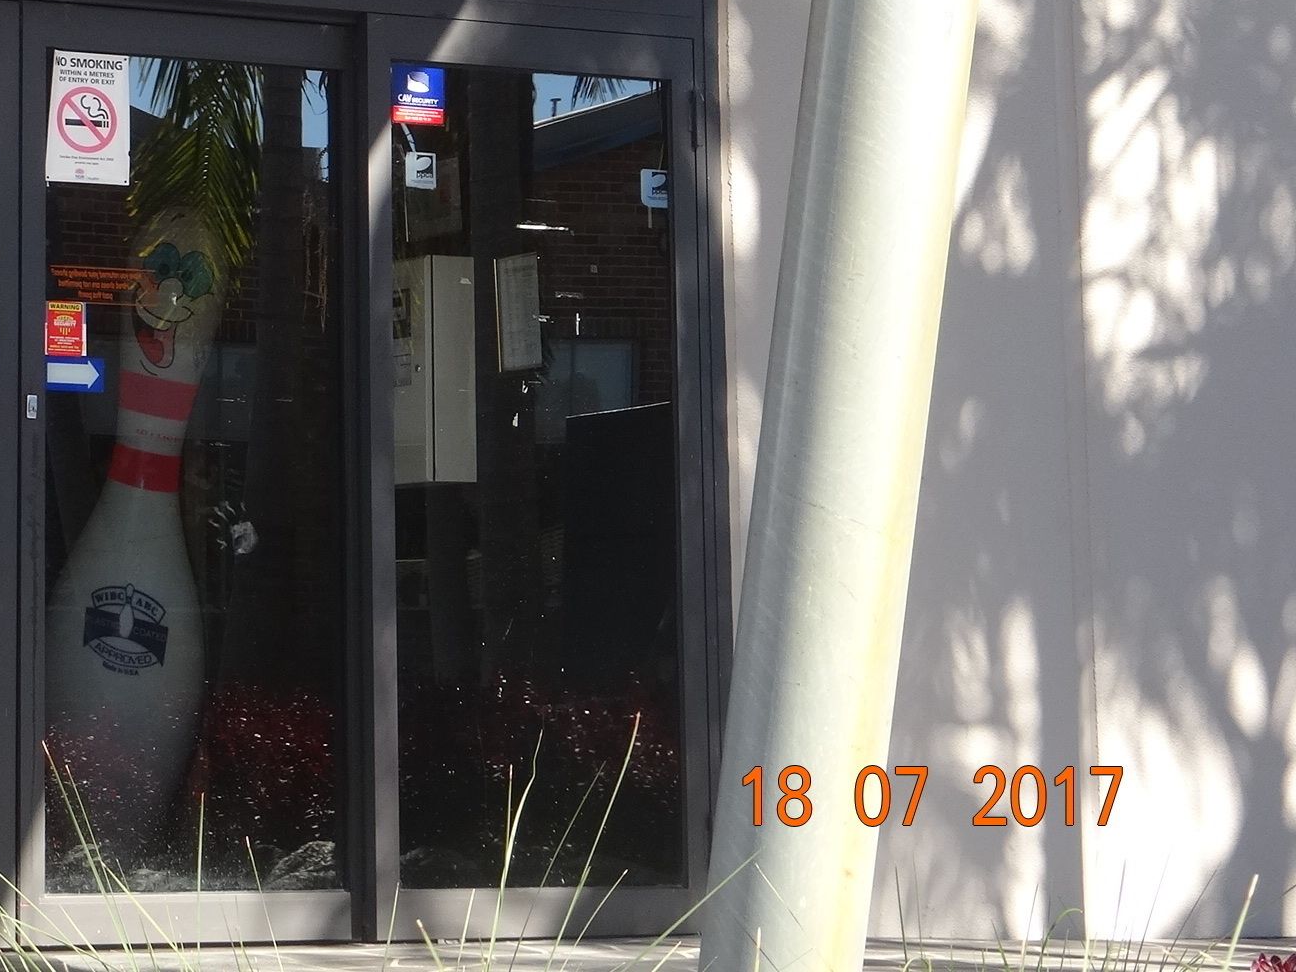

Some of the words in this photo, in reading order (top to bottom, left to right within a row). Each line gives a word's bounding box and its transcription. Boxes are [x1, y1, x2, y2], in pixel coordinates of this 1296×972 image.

[56, 56, 67, 67] NO
[70, 58, 123, 71] SMOKING
[398, 94, 412, 102] CAV
[49, 303, 80, 311] WARNING
[95, 642, 152, 664] APPROVED
